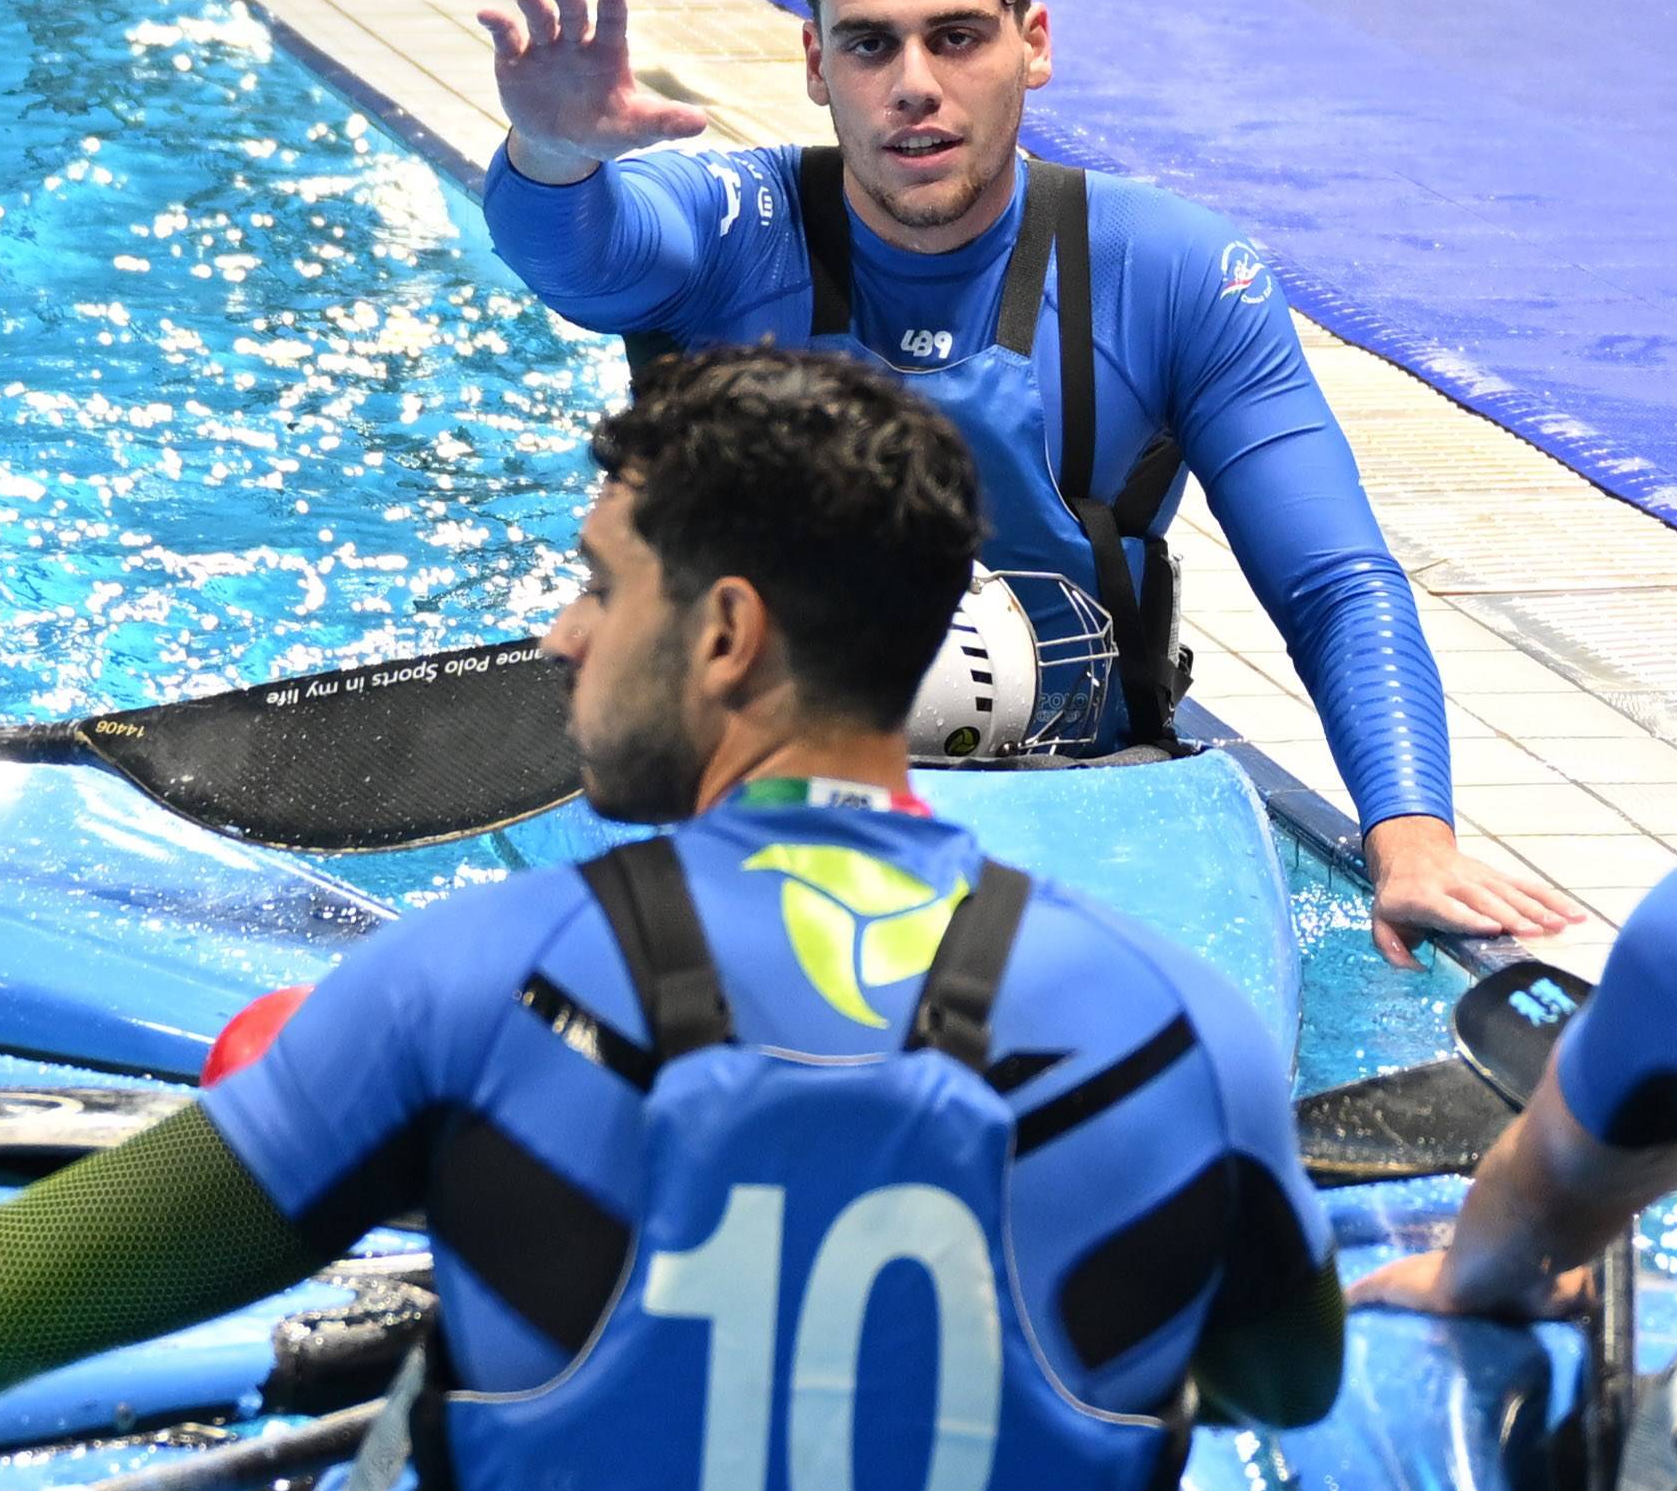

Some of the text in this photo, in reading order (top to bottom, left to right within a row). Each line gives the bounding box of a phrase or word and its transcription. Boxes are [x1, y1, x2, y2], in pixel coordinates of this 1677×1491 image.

[372, 663, 438, 687] Sports
[444, 654, 490, 676] Polo
[306, 680, 340, 699] my
[346, 677, 365, 694] in
[266, 687, 300, 707] life
[95, 719, 146, 739] 14406
